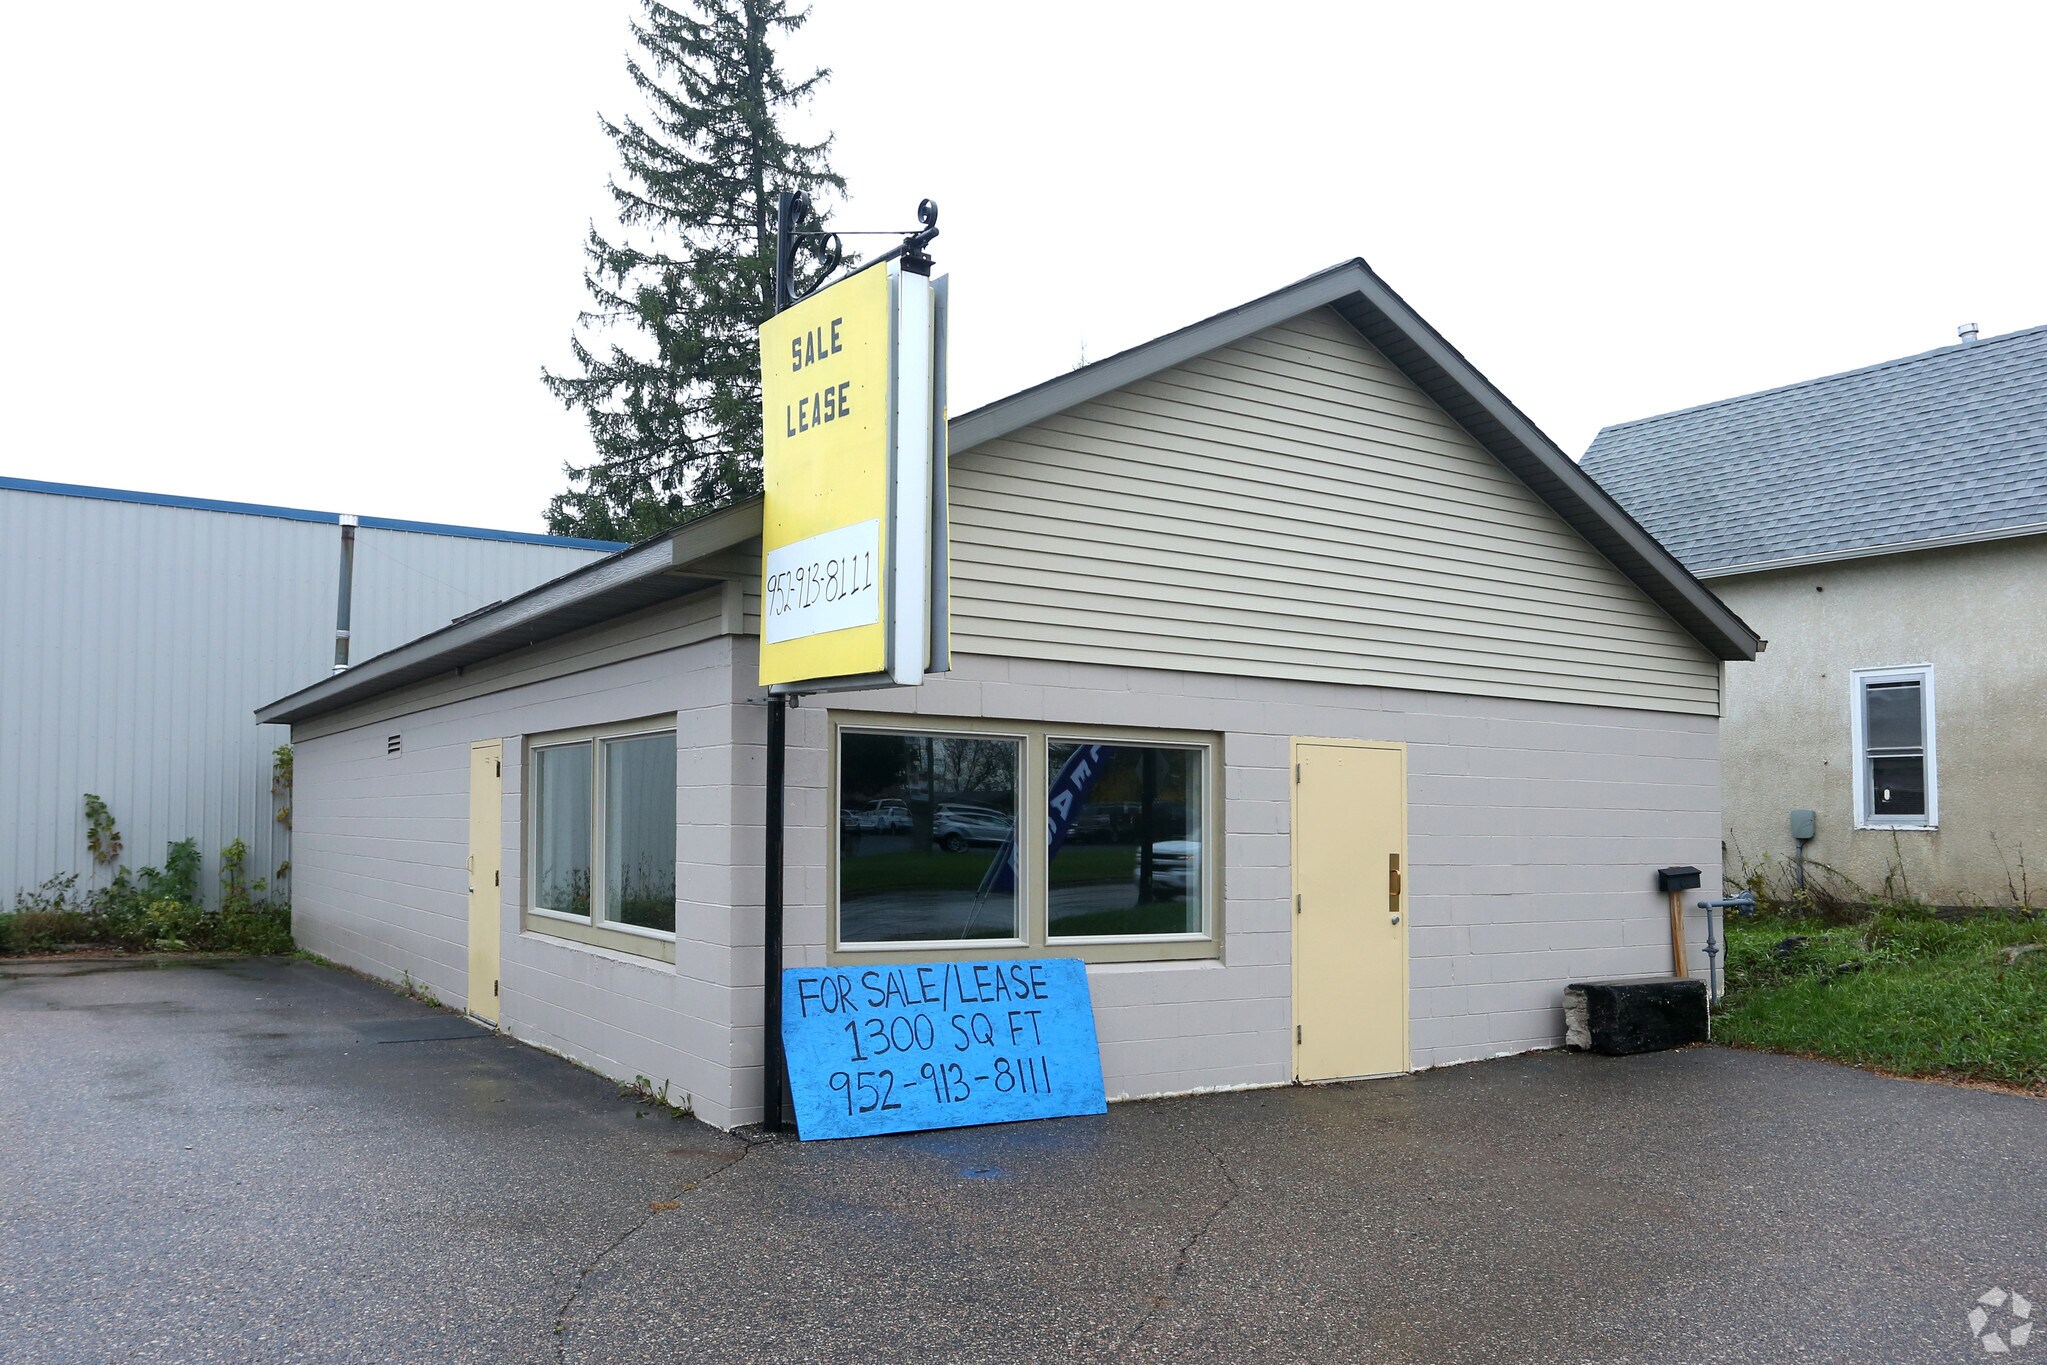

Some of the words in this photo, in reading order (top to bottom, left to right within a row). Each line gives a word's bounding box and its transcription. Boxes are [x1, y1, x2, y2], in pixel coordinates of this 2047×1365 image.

[792, 317, 843, 373] SALE
[787, 380, 851, 438] LEASE
[767, 551, 872, 617] 952-913-8111
[798, 974, 858, 1018] FOR
[861, 963, 1049, 1012] SALE/LEASE
[844, 1013, 935, 1062] 1300
[951, 1012, 995, 1052] SQ
[1008, 1010, 1042, 1046] FT
[829, 1055, 1052, 1117] 952-913-8111
